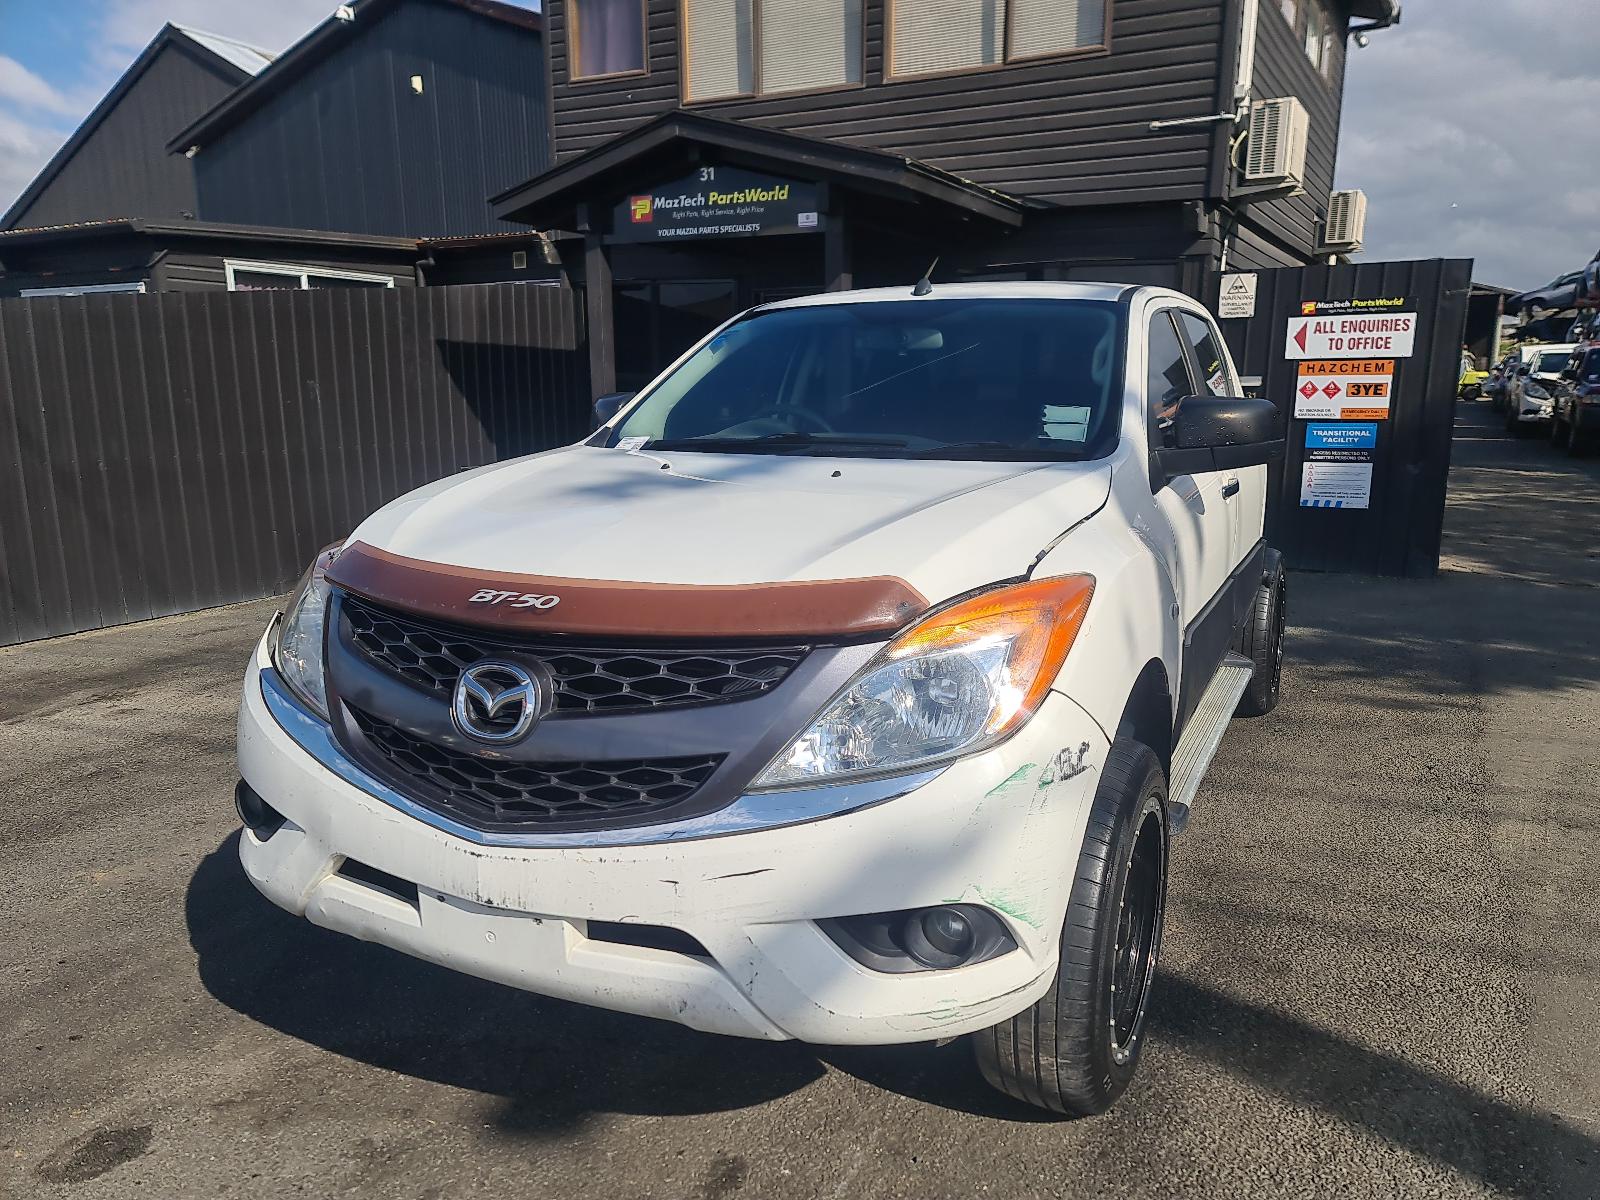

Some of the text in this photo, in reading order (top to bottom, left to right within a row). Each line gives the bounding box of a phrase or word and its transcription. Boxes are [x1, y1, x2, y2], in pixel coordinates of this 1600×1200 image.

[699, 167, 715, 181] 31
[653, 185, 790, 209] MazTech PartsWorld
[701, 209, 715, 217] Right
[736, 206, 750, 215] Right
[676, 227, 698, 235] MAZDA
[698, 226, 719, 234] PARTS
[719, 223, 761, 233] SPECIALISTS
[1315, 297, 1404, 309] MazTech PartsWorld
[1313, 318, 1411, 334] ALL ENQUIRIES
[1328, 337, 1392, 350] TO OFFICE
[1306, 363, 1385, 373] HAZCHEM
[1350, 384, 1383, 396] 3YE
[468, 589, 561, 609] BT-50
